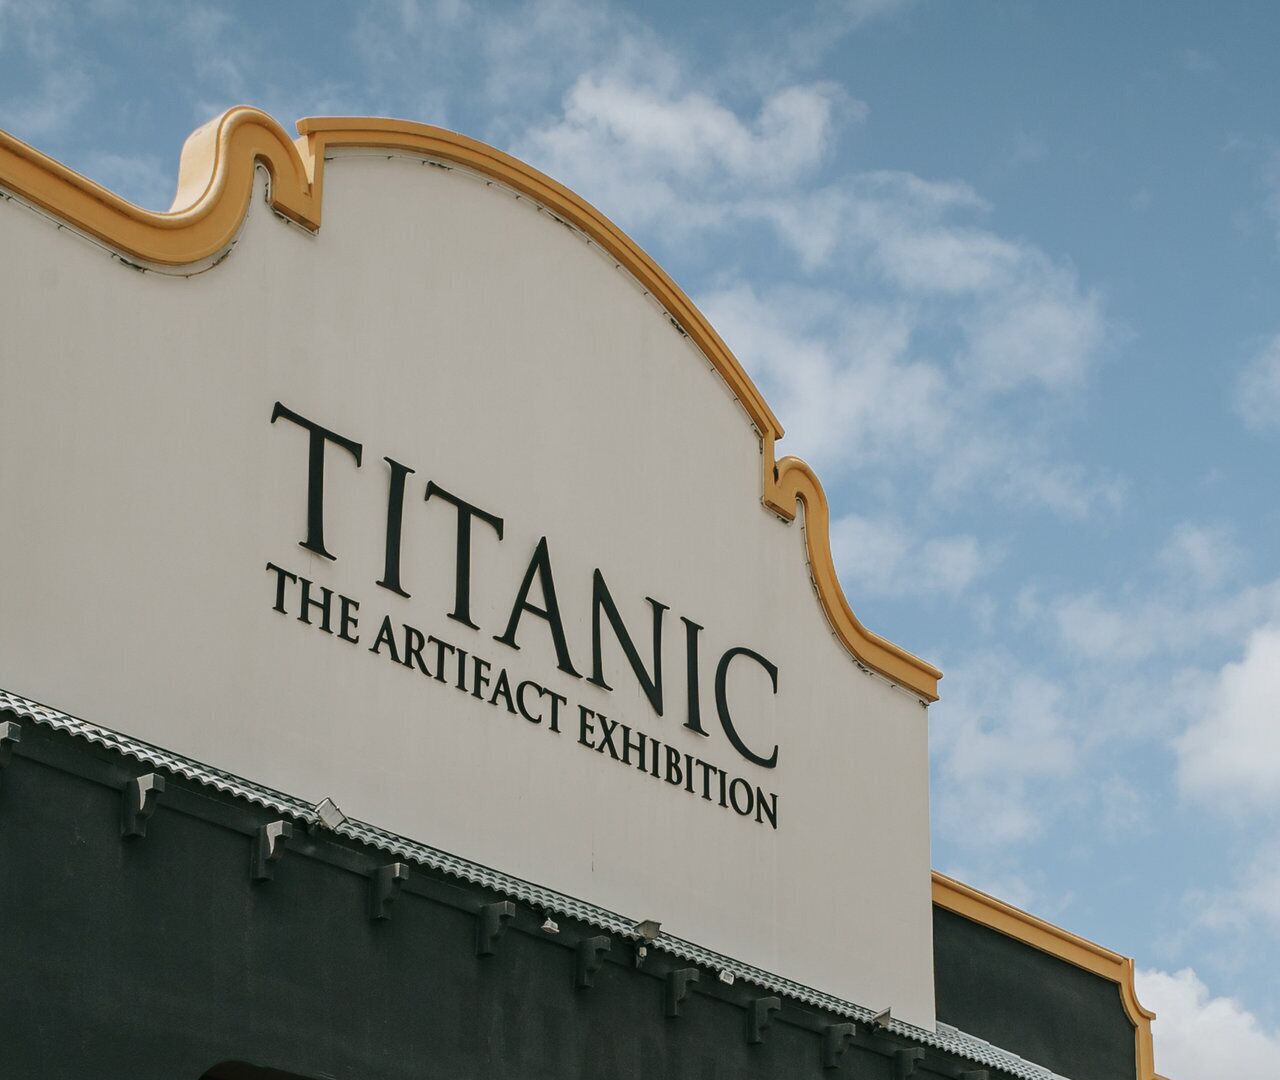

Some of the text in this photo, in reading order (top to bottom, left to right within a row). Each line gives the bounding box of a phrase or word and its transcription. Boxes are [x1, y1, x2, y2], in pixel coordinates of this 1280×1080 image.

[266, 562, 778, 830] THE ARTIFACT EXHIBITION
[270, 401, 779, 769] TITANIC
